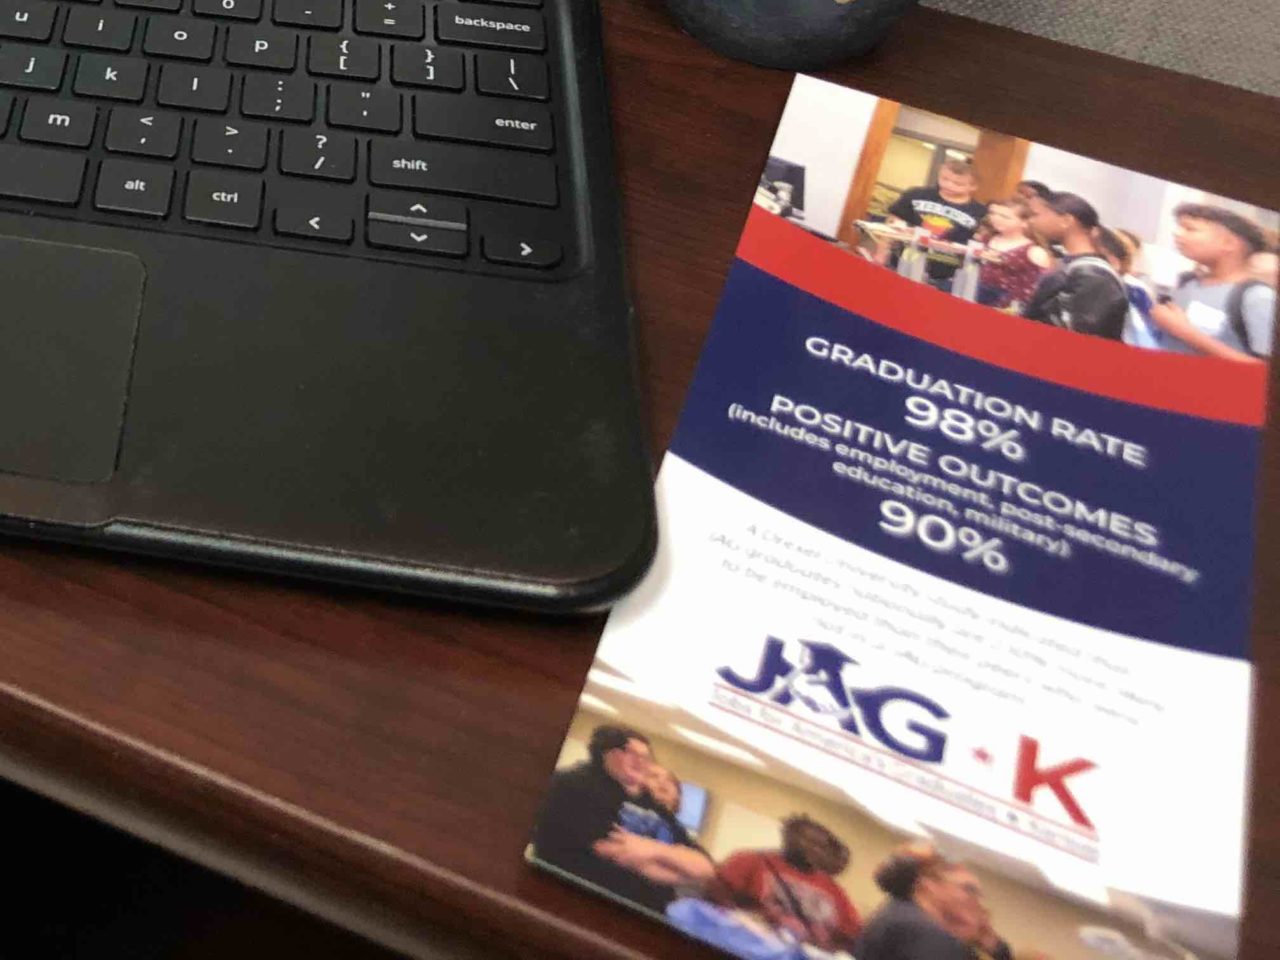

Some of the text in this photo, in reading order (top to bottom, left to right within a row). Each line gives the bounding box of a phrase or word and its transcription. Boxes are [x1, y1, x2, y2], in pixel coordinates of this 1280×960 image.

[15, 11, 29, 22] u
[454, 15, 531, 32] backspace
[97, 19, 104, 31] i
[173, 30, 188, 41] o
[254, 40, 269, 53] p
[24, 57, 36, 73] j
[104, 67, 118, 81] k
[48, 113, 70, 127] m
[494, 118, 537, 131] enter
[392, 158, 428, 171] shift
[124, 179, 146, 191] alt
[212, 191, 238, 203] ctrl
[805, 336, 1149, 469] GRADUATION RATE
[905, 395, 1028, 462] 98%
[770, 394, 1160, 547] POSITIVE OUTCOMES
[728, 402, 1201, 584] (includes employment, post-secondary
[833, 460, 1071, 559] education, military)
[879, 499, 1011, 575] 90%
[716, 634, 951, 764] JAG
[1012, 734, 1099, 832] K
